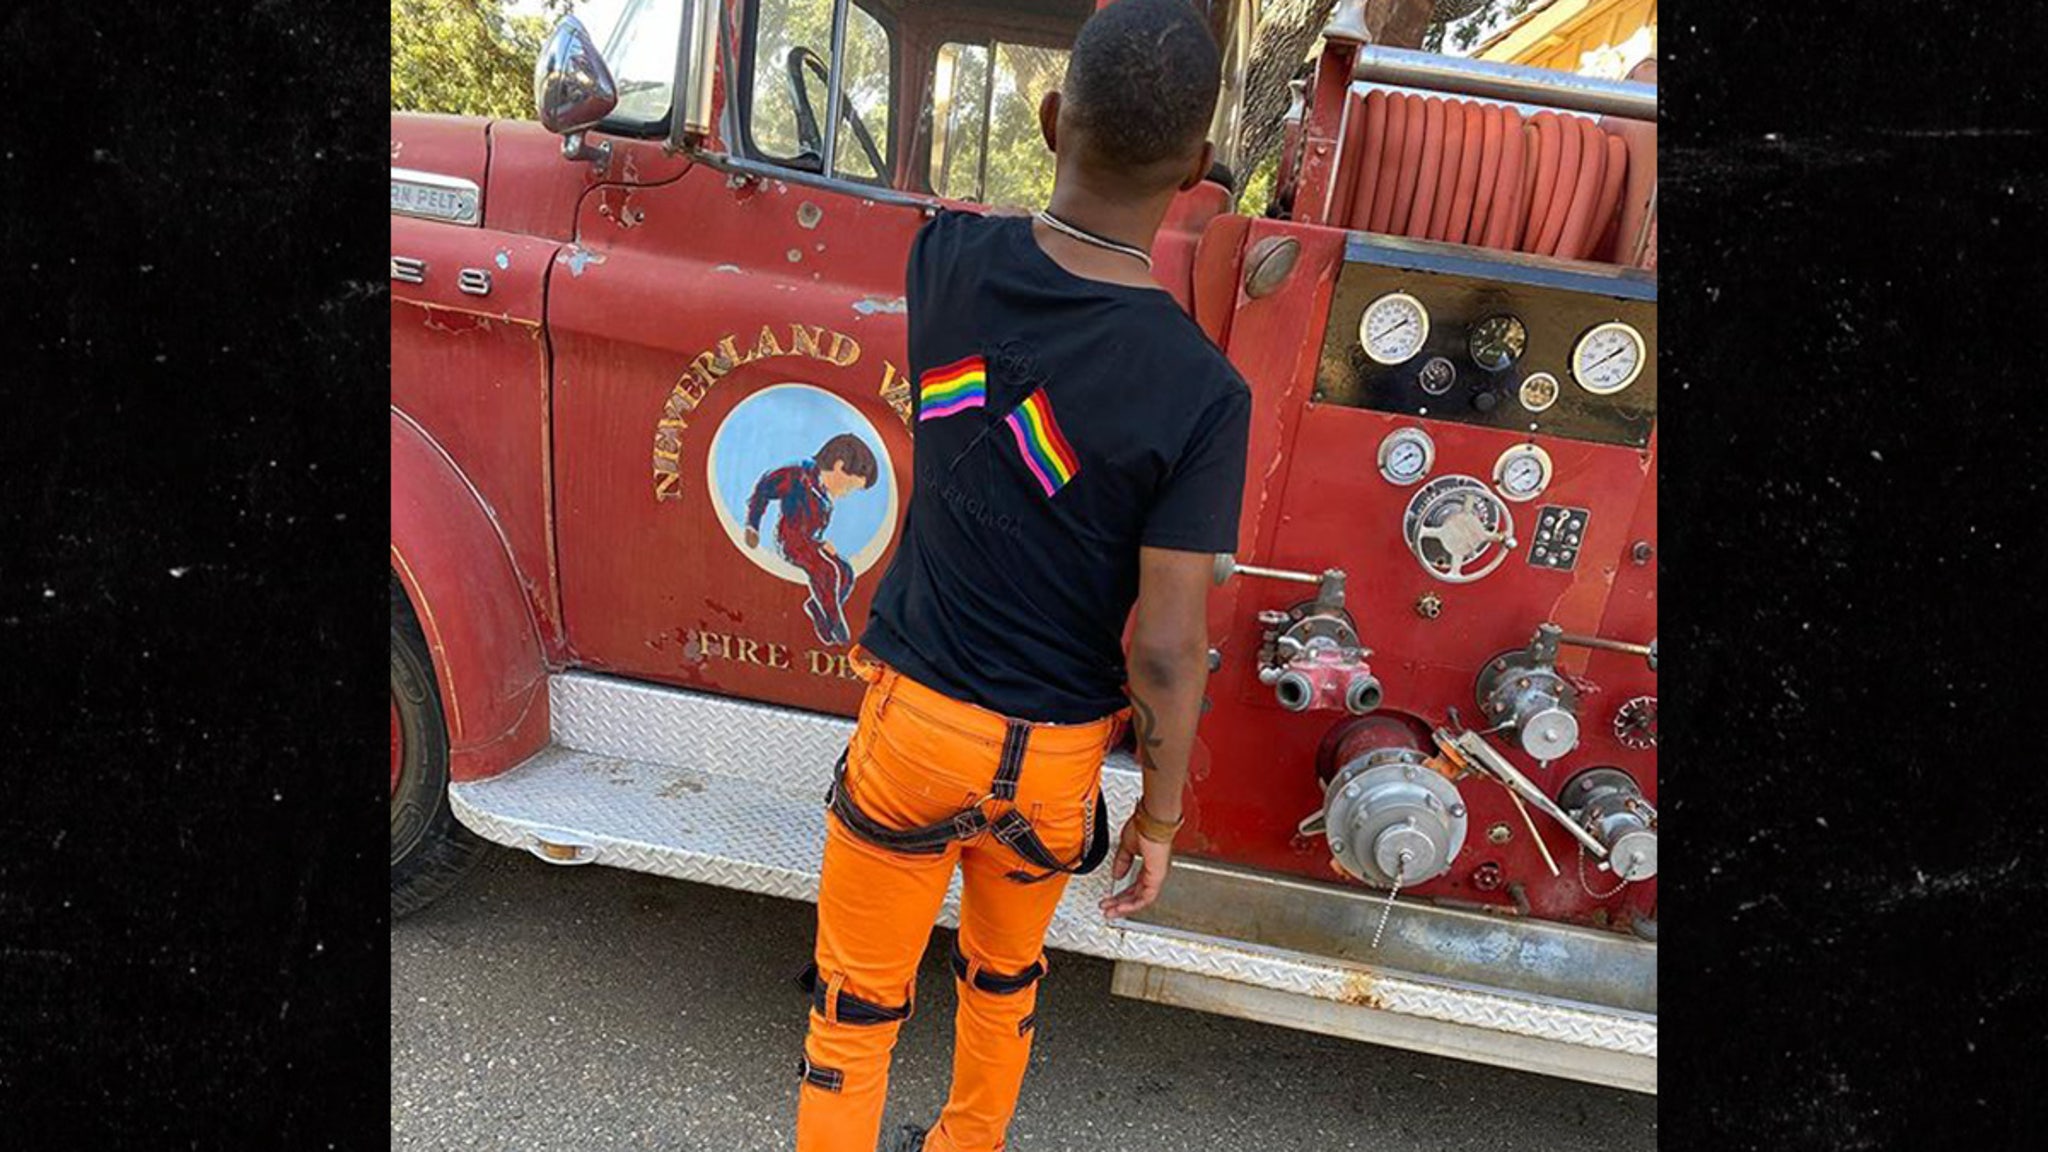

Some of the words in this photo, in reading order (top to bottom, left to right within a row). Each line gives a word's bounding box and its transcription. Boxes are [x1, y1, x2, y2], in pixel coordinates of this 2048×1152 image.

[418, 189, 457, 209] PELT
[653, 323, 862, 503] NEVERLAND
[878, 358, 914, 440] VA
[698, 630, 793, 669] FIRE
